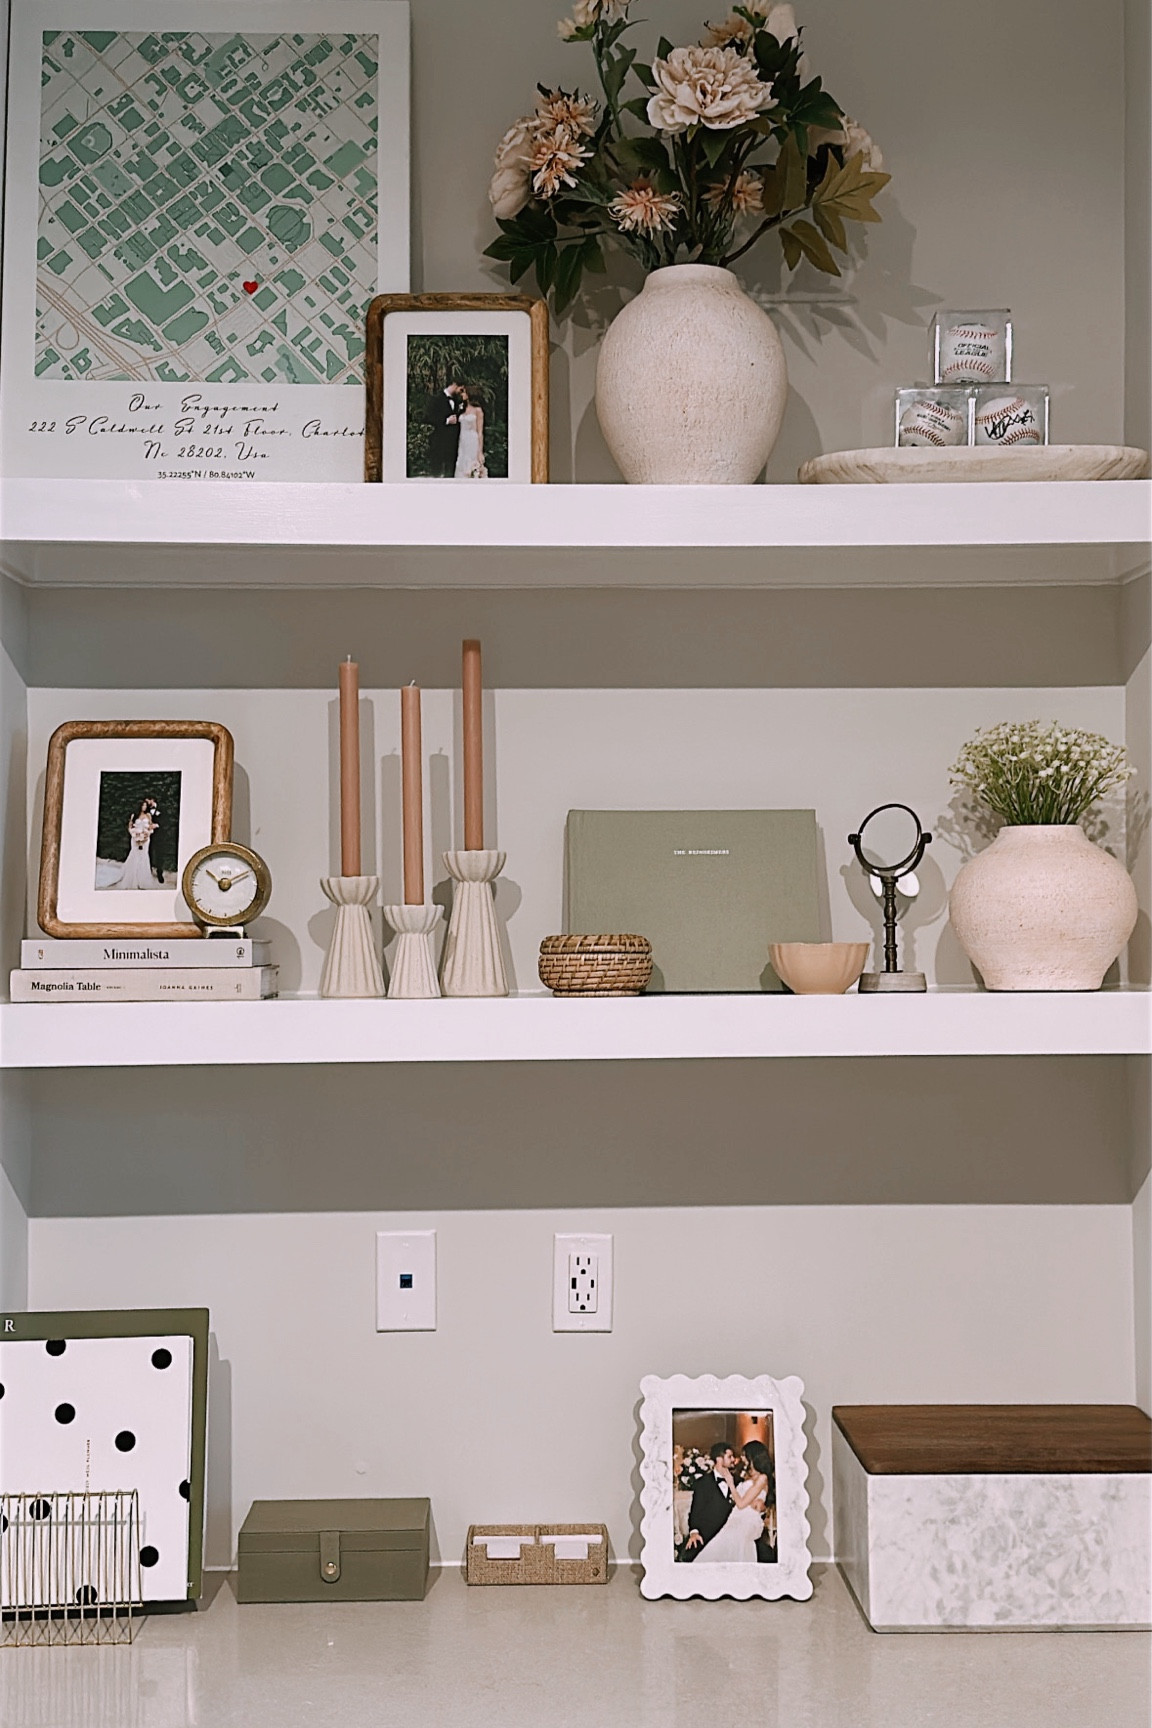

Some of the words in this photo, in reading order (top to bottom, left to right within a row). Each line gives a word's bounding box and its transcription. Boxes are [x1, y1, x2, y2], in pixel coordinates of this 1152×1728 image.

[957, 343, 989, 351] OFFICIAL
[954, 350, 988, 358] LEAGUE
[128, 393, 162, 412] Our
[181, 394, 279, 418] Engagement
[28, 421, 57, 432] 222
[65, 415, 87, 434] S
[88, 416, 165, 435] Caldwell
[174, 417, 195, 436] St
[202, 424, 234, 435] 21st
[302, 419, 366, 438] Charlot
[144, 440, 169, 459] Nc
[235, 441, 271, 460] Usa
[103, 948, 169, 960] Minimalista
[31, 982, 74, 992] Magnolia
[76, 982, 101, 991] Table
[4, 1319, 17, 1332] R
